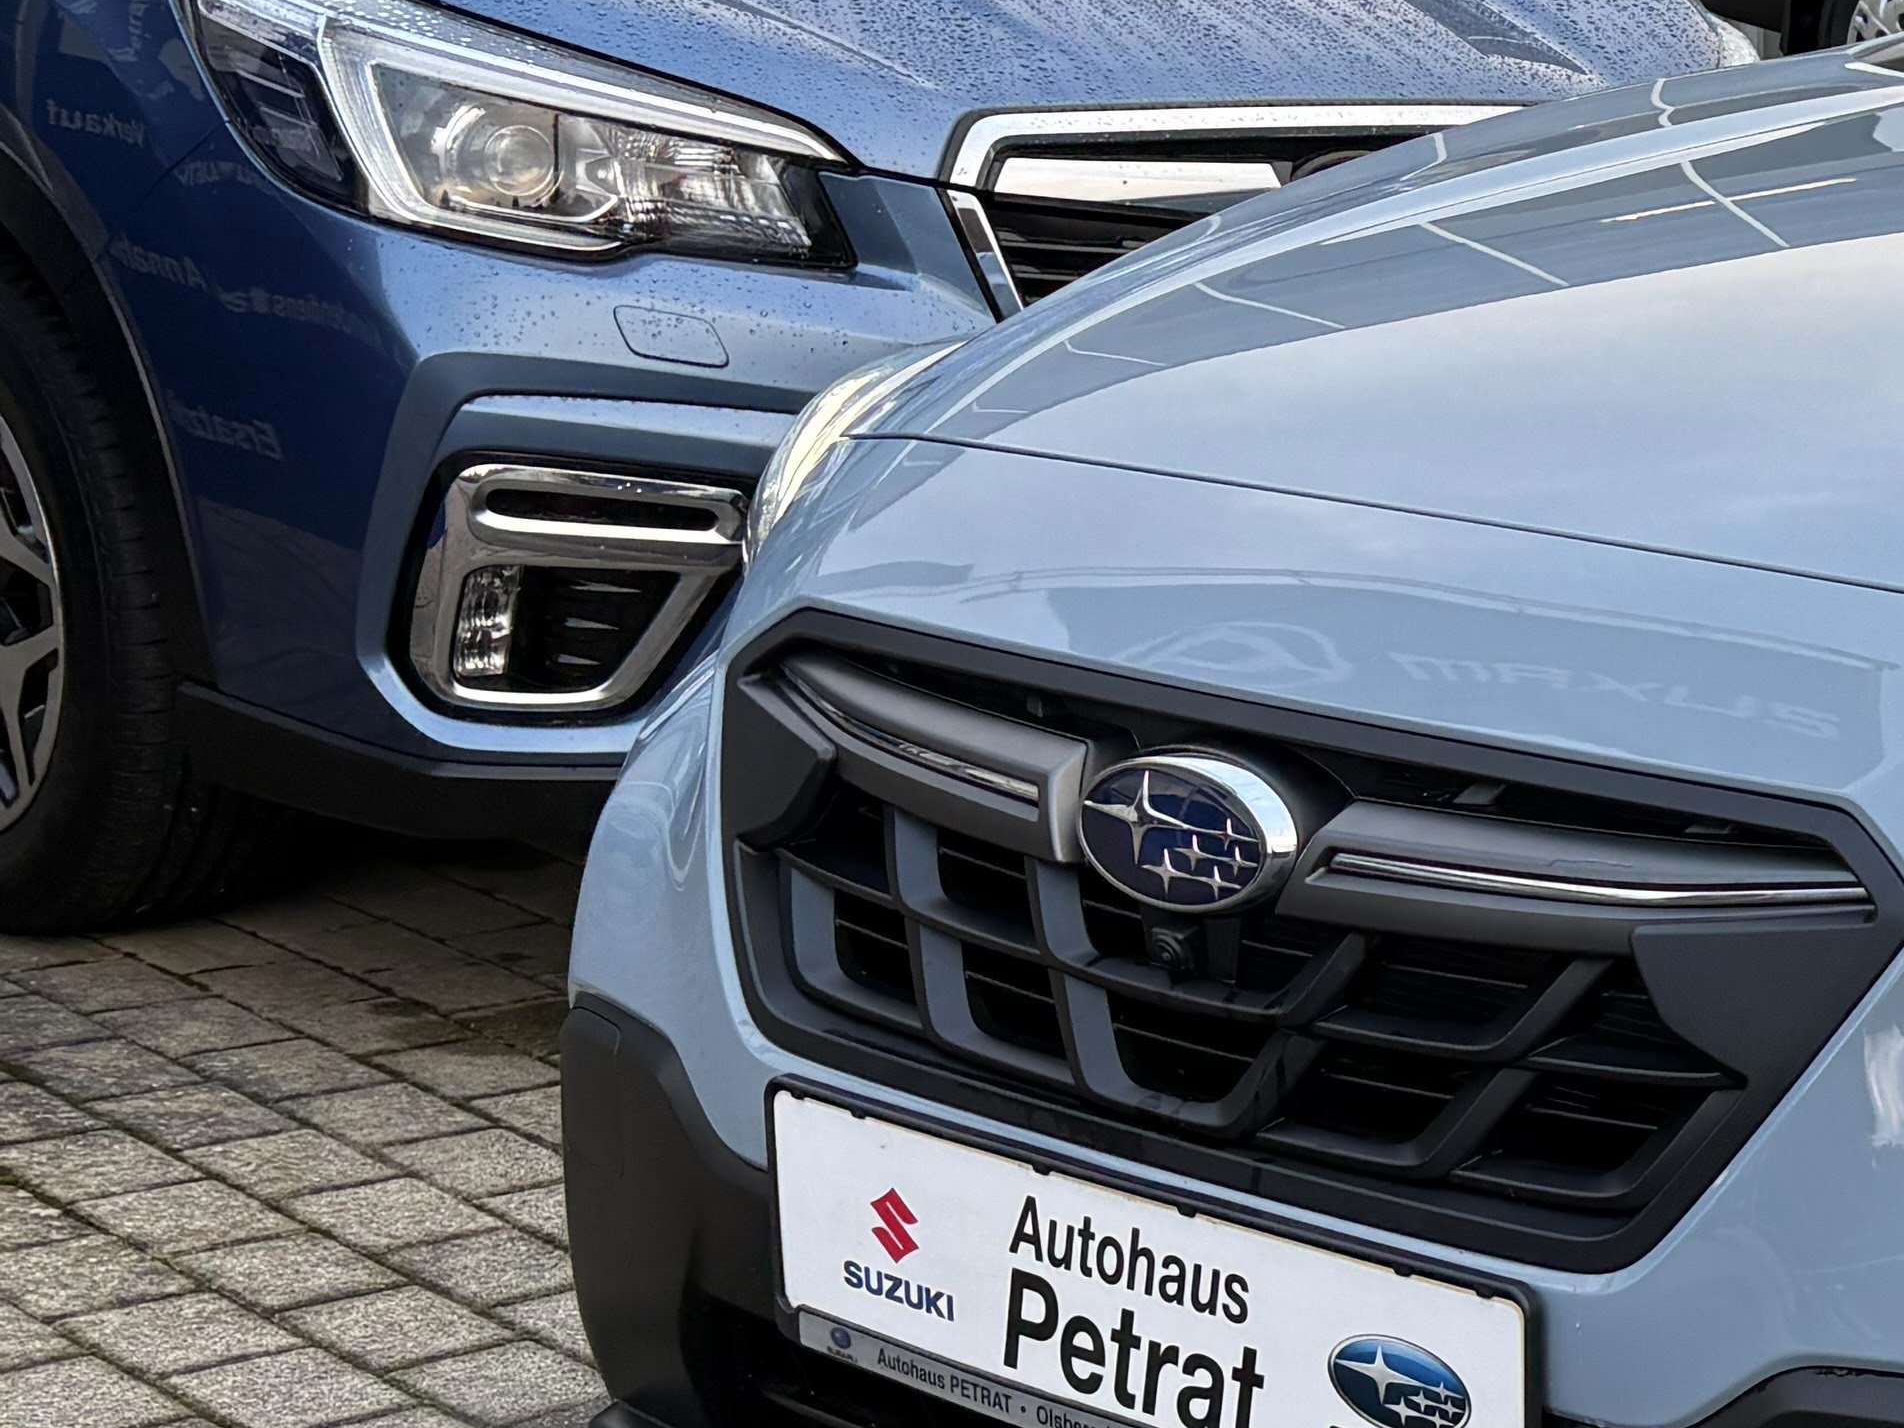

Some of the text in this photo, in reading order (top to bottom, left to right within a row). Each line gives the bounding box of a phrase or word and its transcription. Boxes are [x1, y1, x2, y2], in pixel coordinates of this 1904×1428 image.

[843, 1259, 955, 1322] SUZUKI
[1008, 1194, 1250, 1324] Autohaus
[876, 1347, 945, 1390] Autohaus
[950, 1375, 1014, 1415] PETRAT
